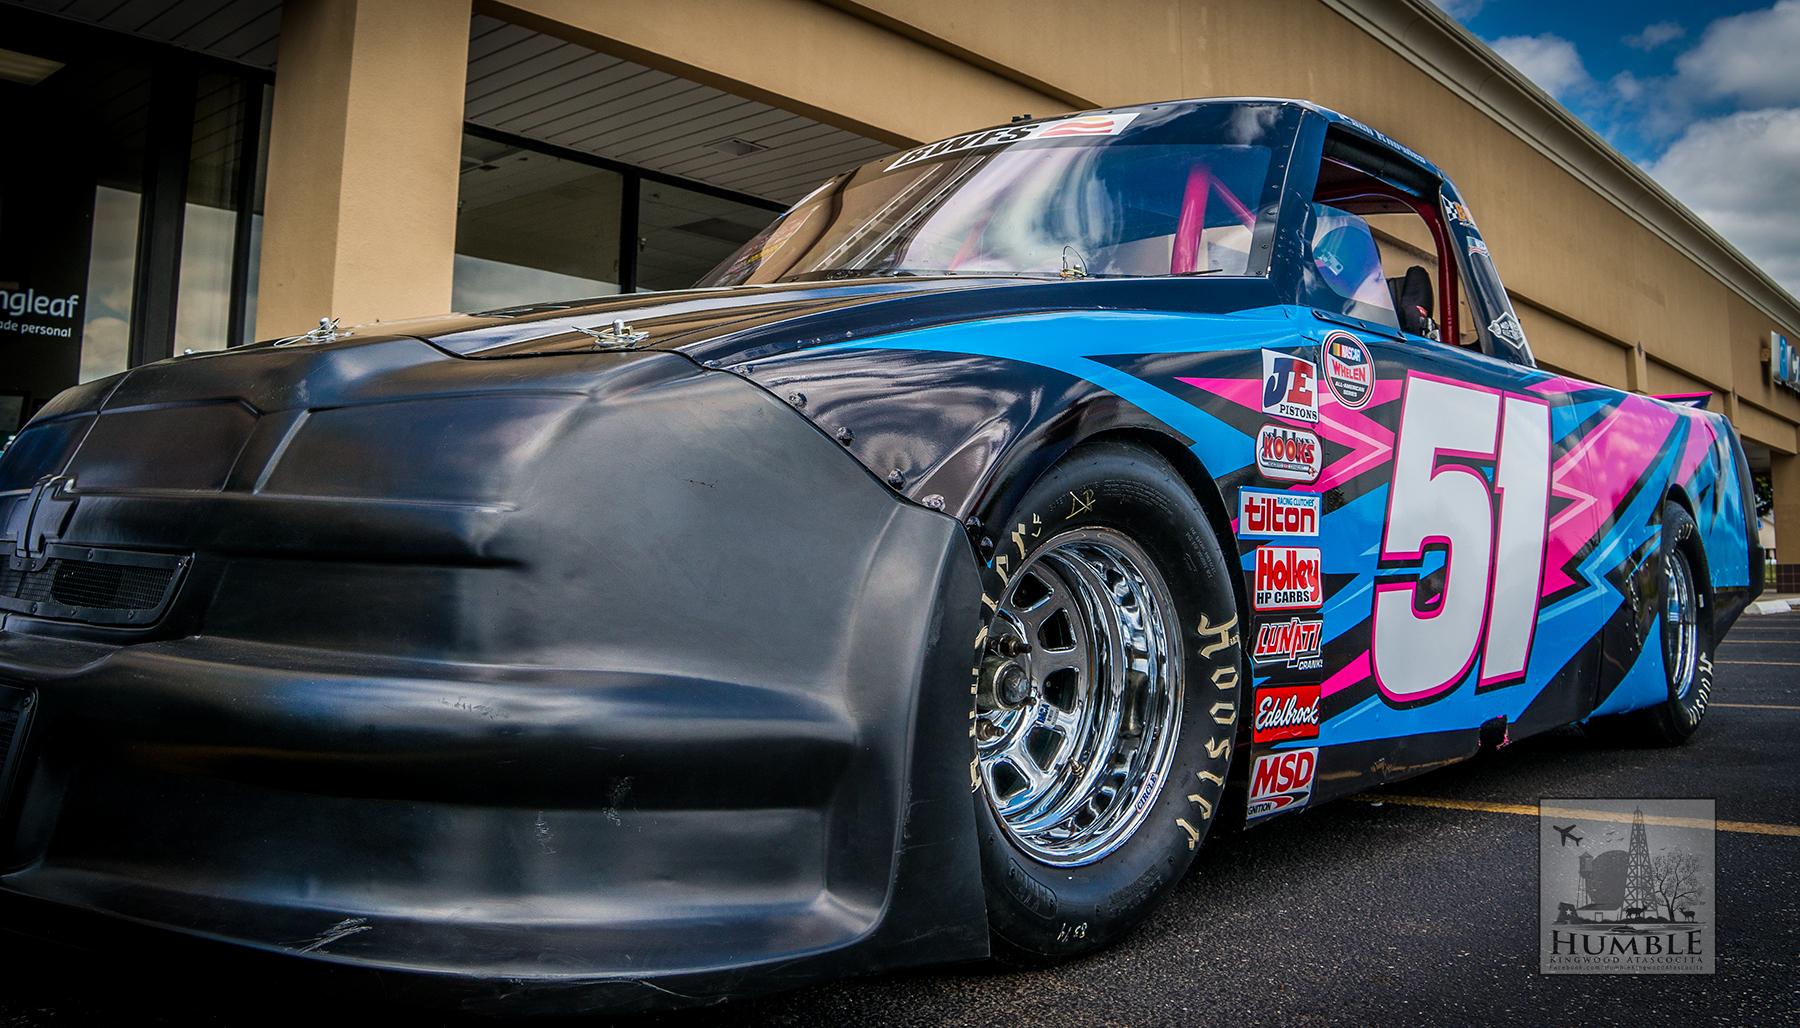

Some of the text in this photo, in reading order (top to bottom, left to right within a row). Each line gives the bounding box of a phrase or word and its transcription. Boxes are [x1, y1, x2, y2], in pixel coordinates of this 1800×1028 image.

[21, 323, 71, 338] personal
[1264, 357, 1313, 408] JE
[1331, 358, 1366, 383] WHELEN
[1279, 403, 1318, 421] PISTONS
[1263, 434, 1315, 464] KOOKS
[1245, 497, 1315, 533] tilton
[1277, 496, 1293, 506] RACING
[1373, 370, 1549, 701] 51
[1257, 549, 1319, 602] Holley
[1256, 590, 1310, 605] HP CARBS
[1254, 619, 1322, 660] LUNATI
[1254, 694, 1321, 732] Edelbrock
[1136, 773, 1157, 811] CIRCLE
[1250, 751, 1315, 798] MSD
